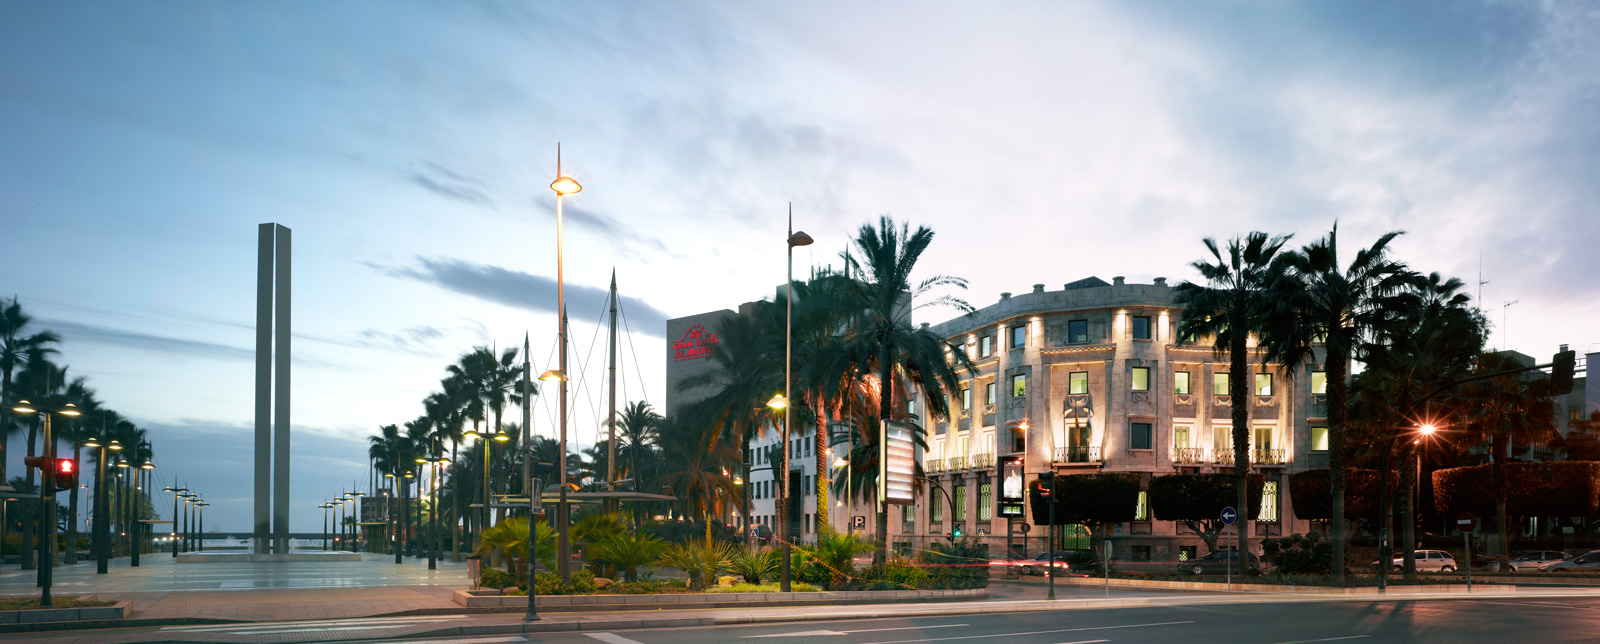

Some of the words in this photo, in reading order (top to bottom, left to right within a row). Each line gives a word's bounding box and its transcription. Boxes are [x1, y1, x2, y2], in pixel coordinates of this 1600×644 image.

[673, 340, 693, 350] GRAN
[696, 336, 720, 346] HOTEL
[855, 516, 864, 526] P
